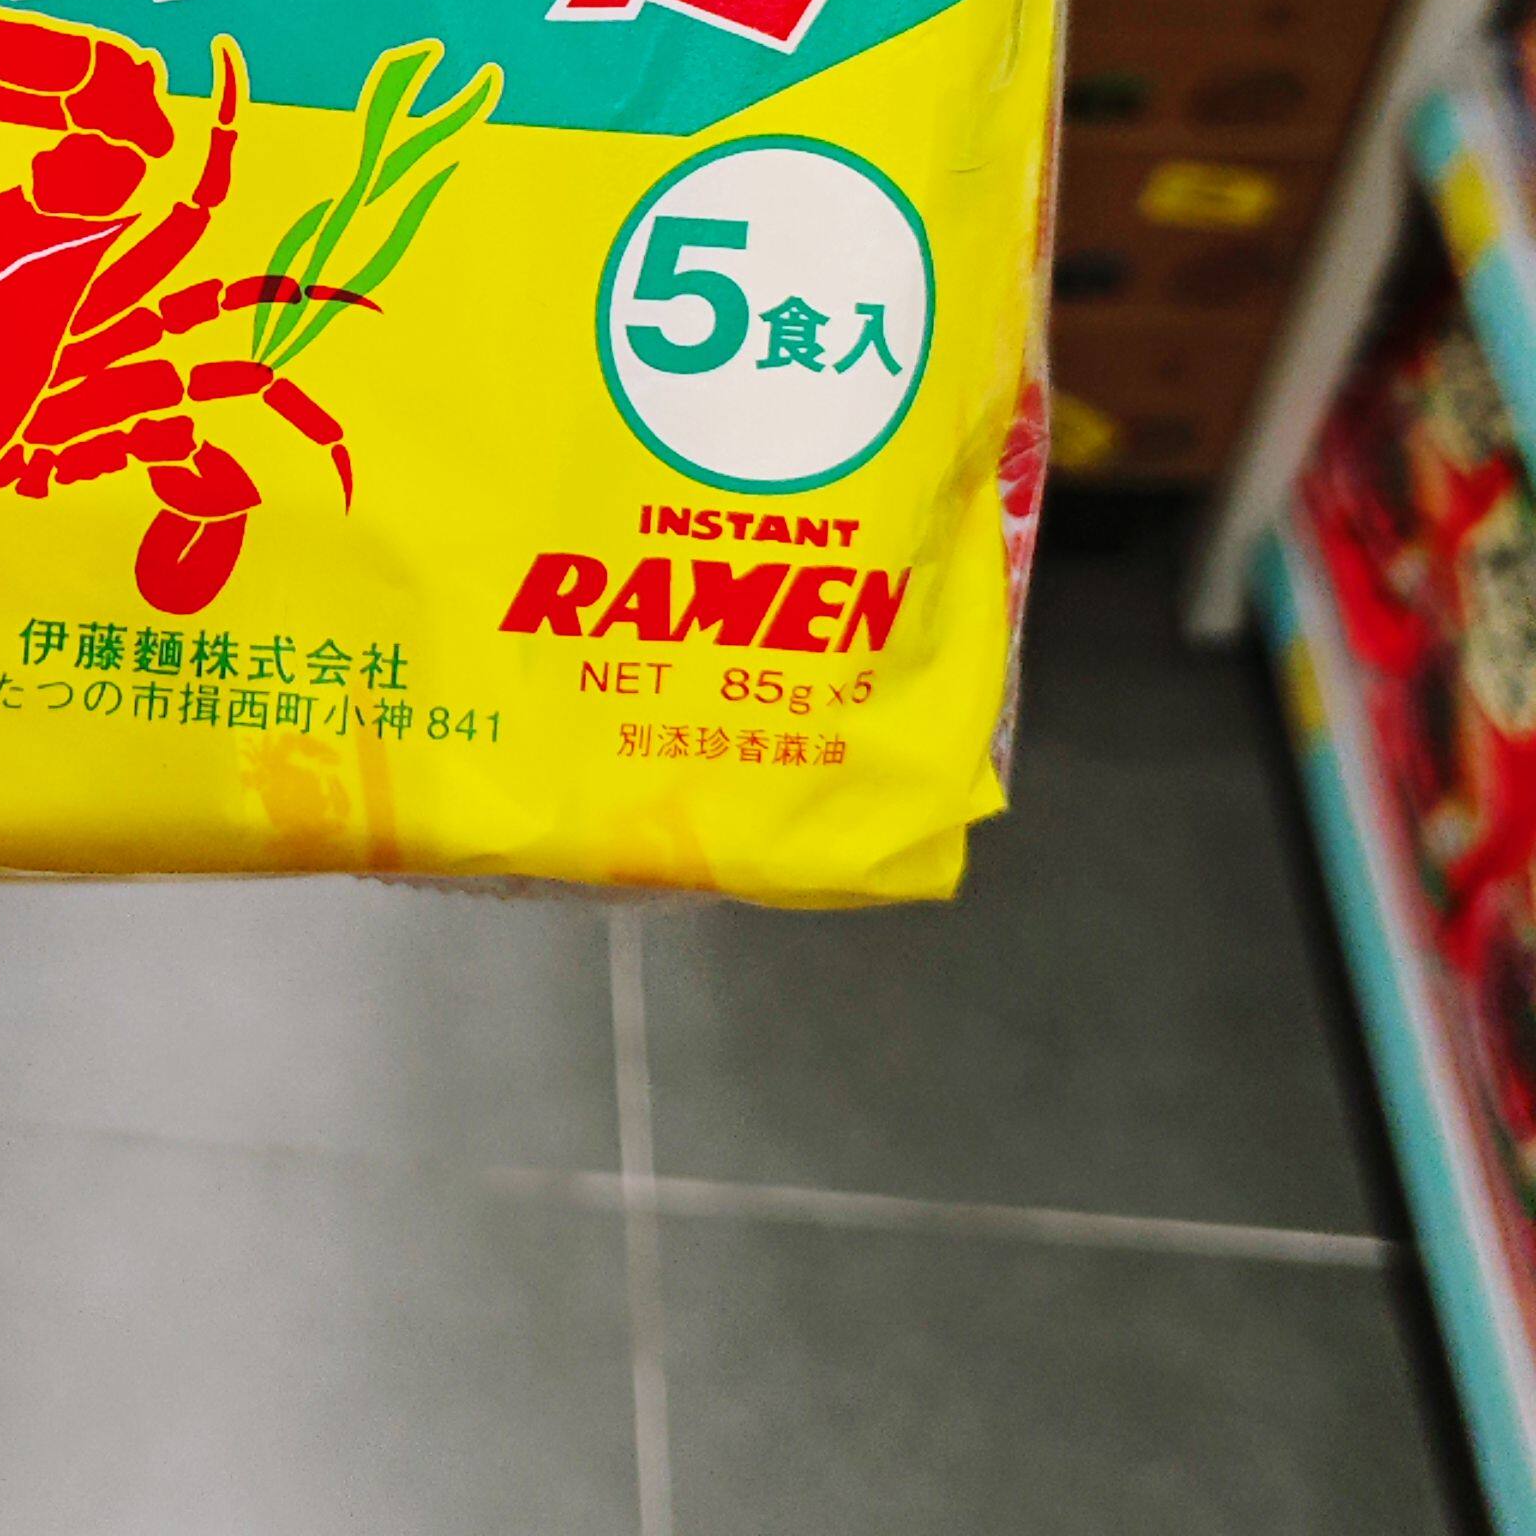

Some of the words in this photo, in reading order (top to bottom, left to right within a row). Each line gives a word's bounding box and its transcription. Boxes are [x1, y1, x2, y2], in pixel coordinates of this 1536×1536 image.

[624, 215, 903, 376] 5食入
[637, 504, 860, 549] INSTANT
[498, 552, 913, 654] RAMEN
[579, 660, 673, 695] NET
[720, 666, 813, 715] 85g
